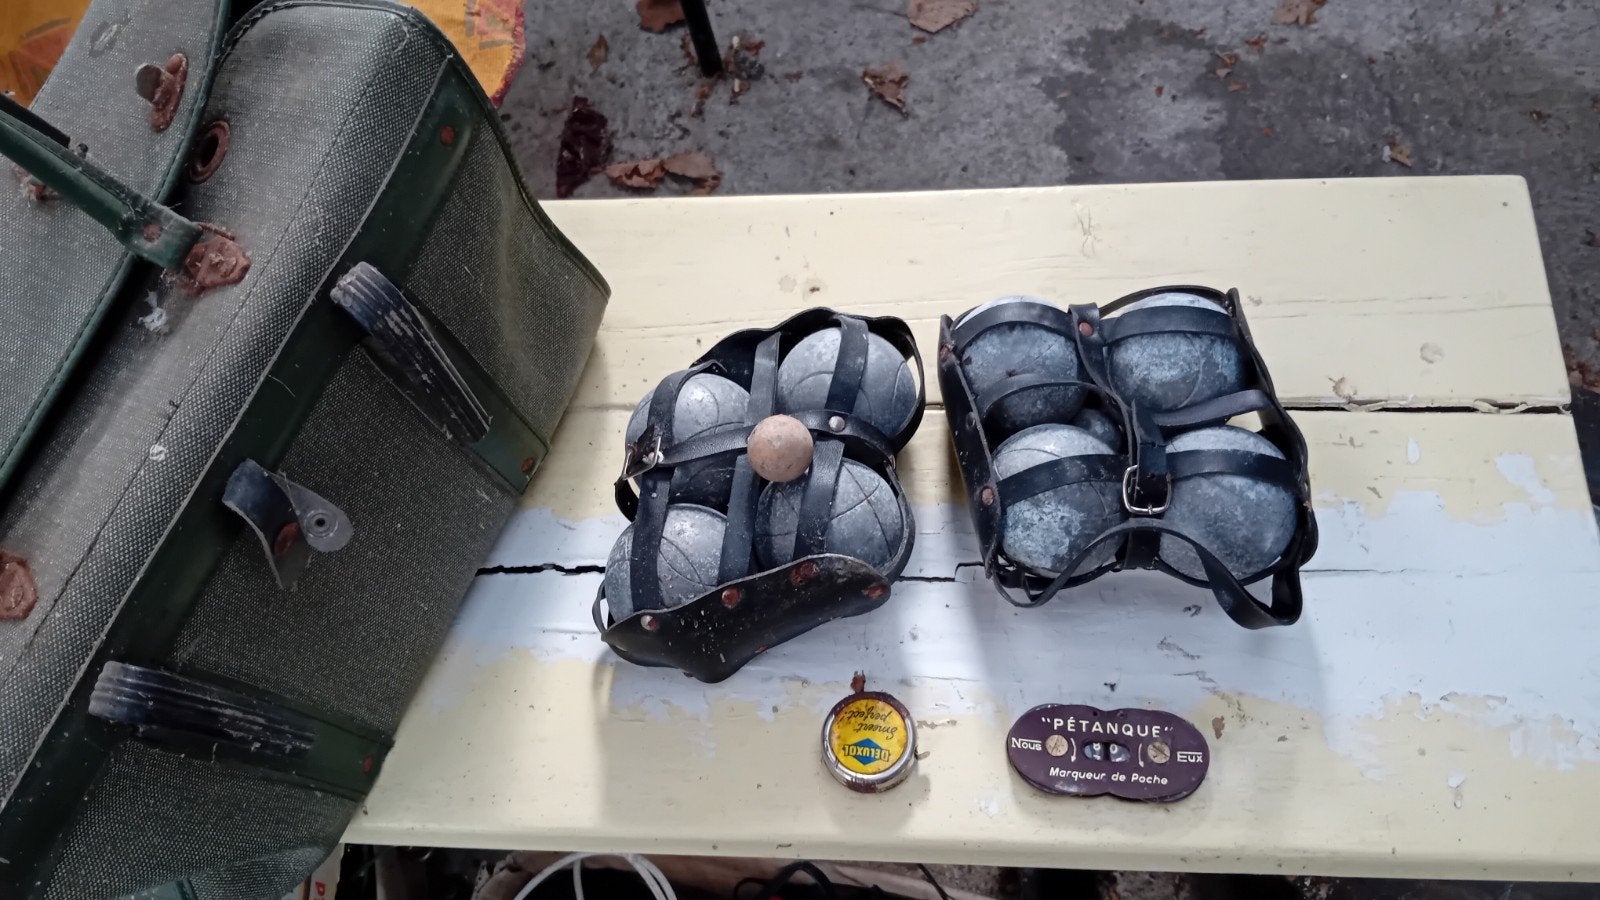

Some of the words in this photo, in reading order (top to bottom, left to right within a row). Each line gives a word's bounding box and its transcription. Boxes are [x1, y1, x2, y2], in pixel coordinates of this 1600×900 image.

[840, 705, 892, 722] perfect!
[853, 722, 898, 740] Smeert
[1011, 737, 1042, 751] Nous
[842, 744, 891, 762] DELUXOL
[1176, 750, 1203, 763] Eux
[1049, 766, 1106, 781] Marqueur
[1111, 772, 1126, 782] de
[1131, 773, 1168, 785] Poche
